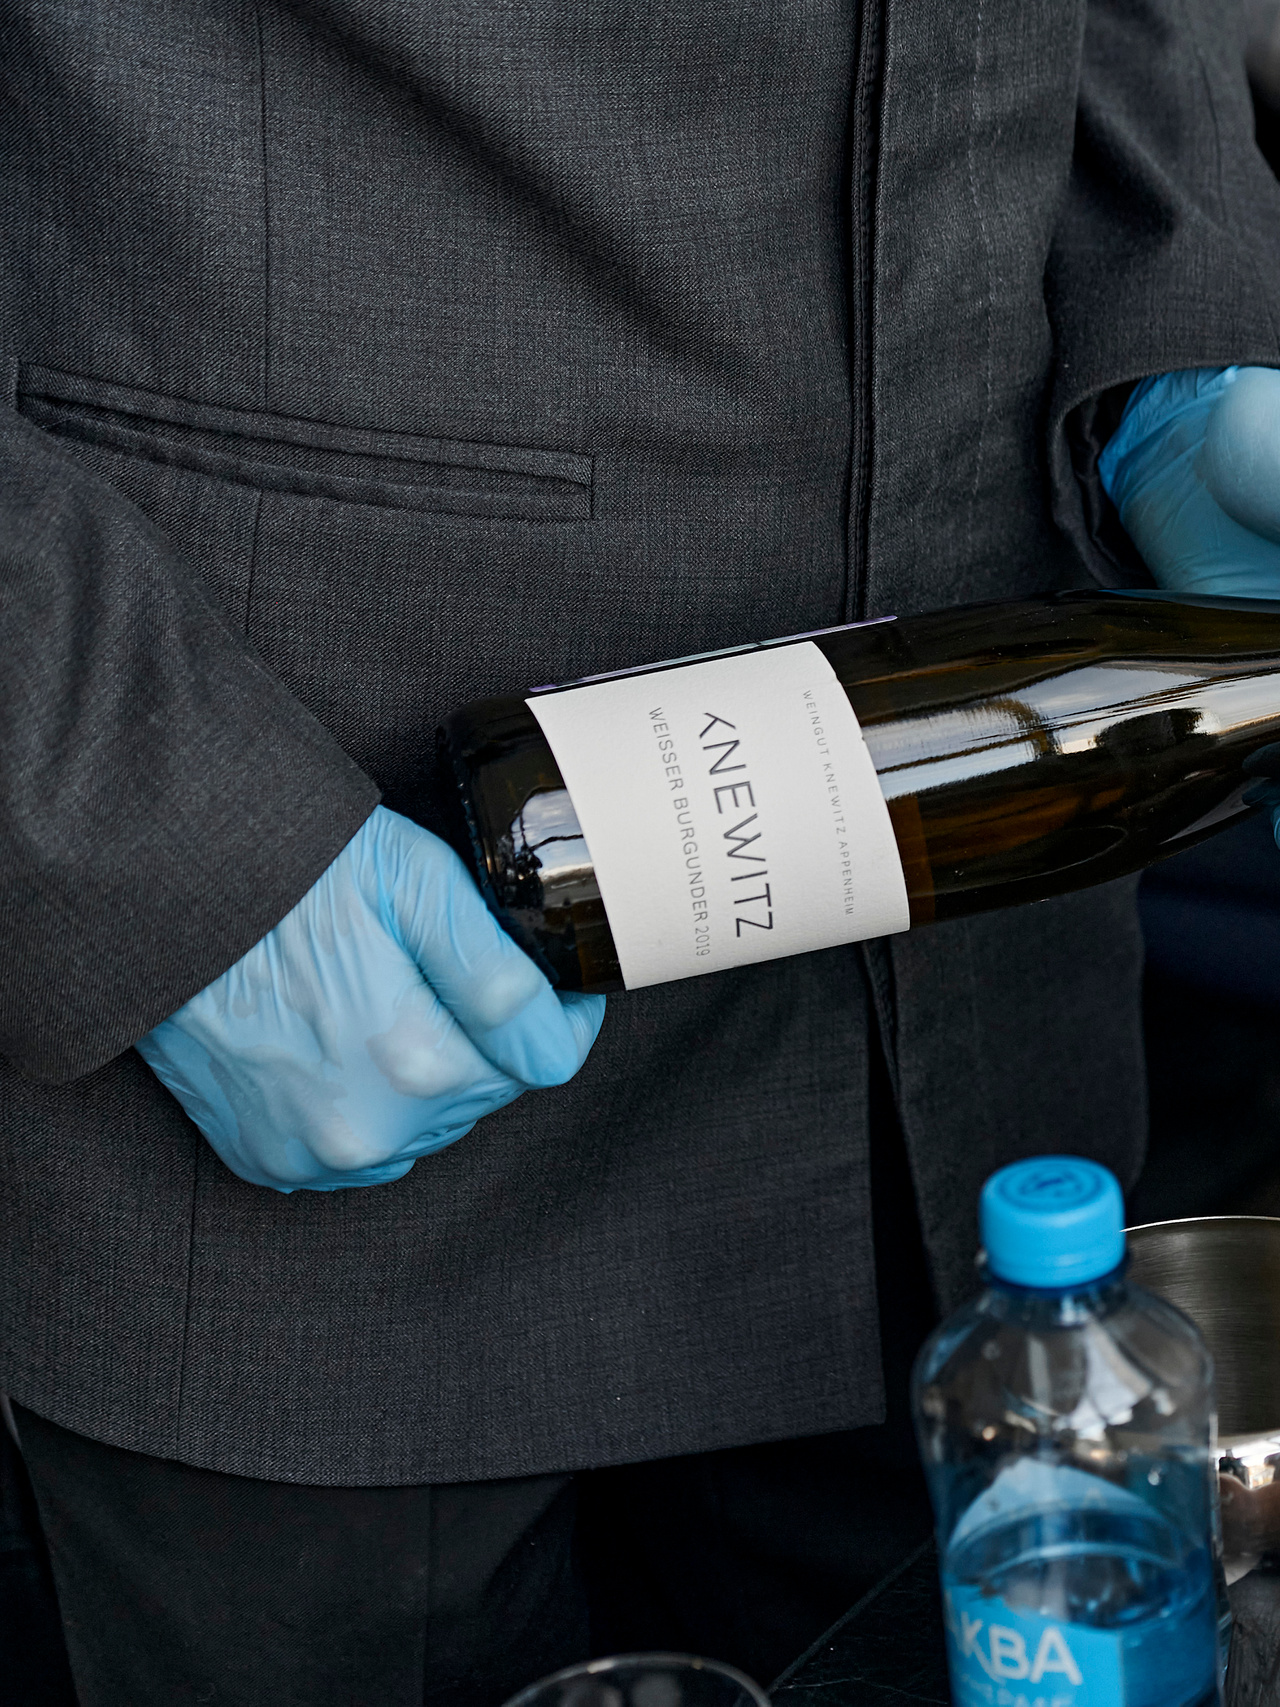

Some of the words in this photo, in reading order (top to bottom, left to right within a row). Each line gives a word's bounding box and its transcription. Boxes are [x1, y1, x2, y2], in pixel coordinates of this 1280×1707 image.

[649, 706, 684, 791] WEISSER
[673, 797, 709, 923] BURGUNDER
[695, 926, 711, 956] 2019
[699, 712, 774, 938] KNEWITZ
[803, 690, 829, 755] WEINGUT
[823, 762, 847, 834] KNEWITZ
[839, 841, 854, 915] APPENHEIM
